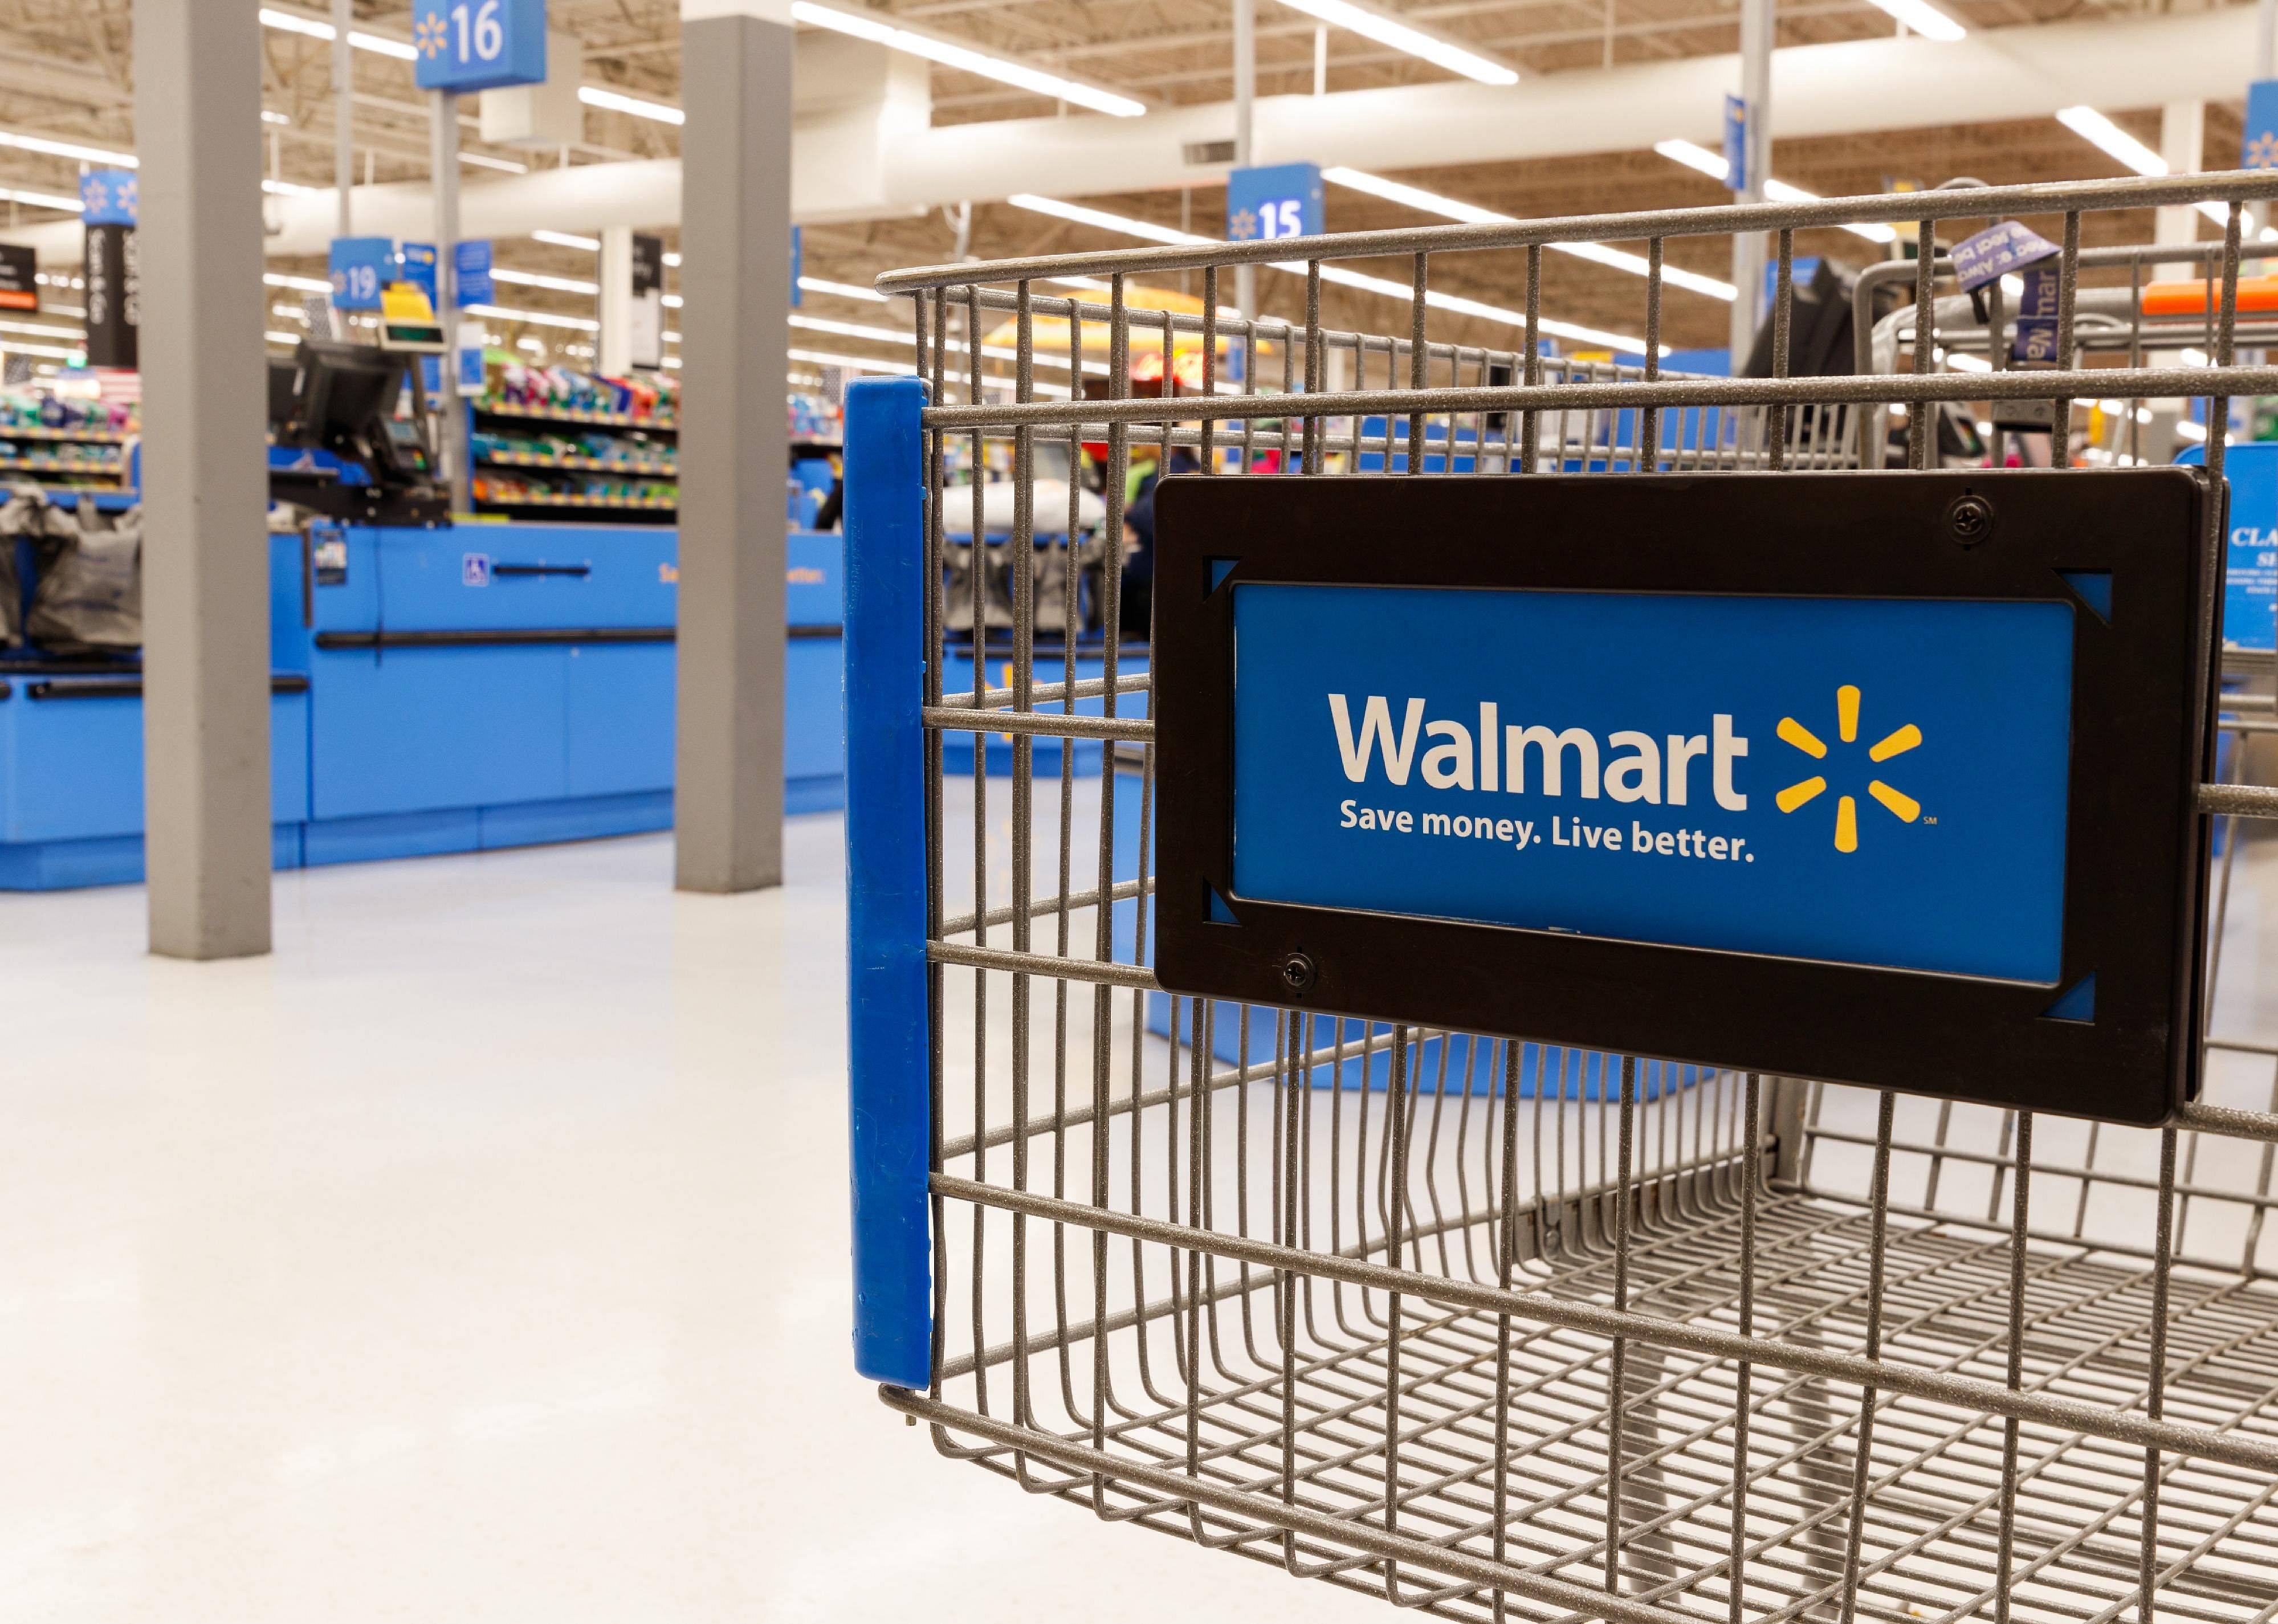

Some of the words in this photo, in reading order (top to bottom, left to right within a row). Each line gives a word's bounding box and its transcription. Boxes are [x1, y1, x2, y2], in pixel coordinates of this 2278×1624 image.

[451, 0, 502, 63] 16
[1259, 200, 1302, 239] 15
[348, 266, 376, 300] 19
[1329, 694, 1748, 811] Walmart
[1341, 800, 1413, 833] Save
[1423, 814, 1541, 850] money.
[1553, 816, 1622, 850] Live
[1633, 821, 1754, 863] better.
